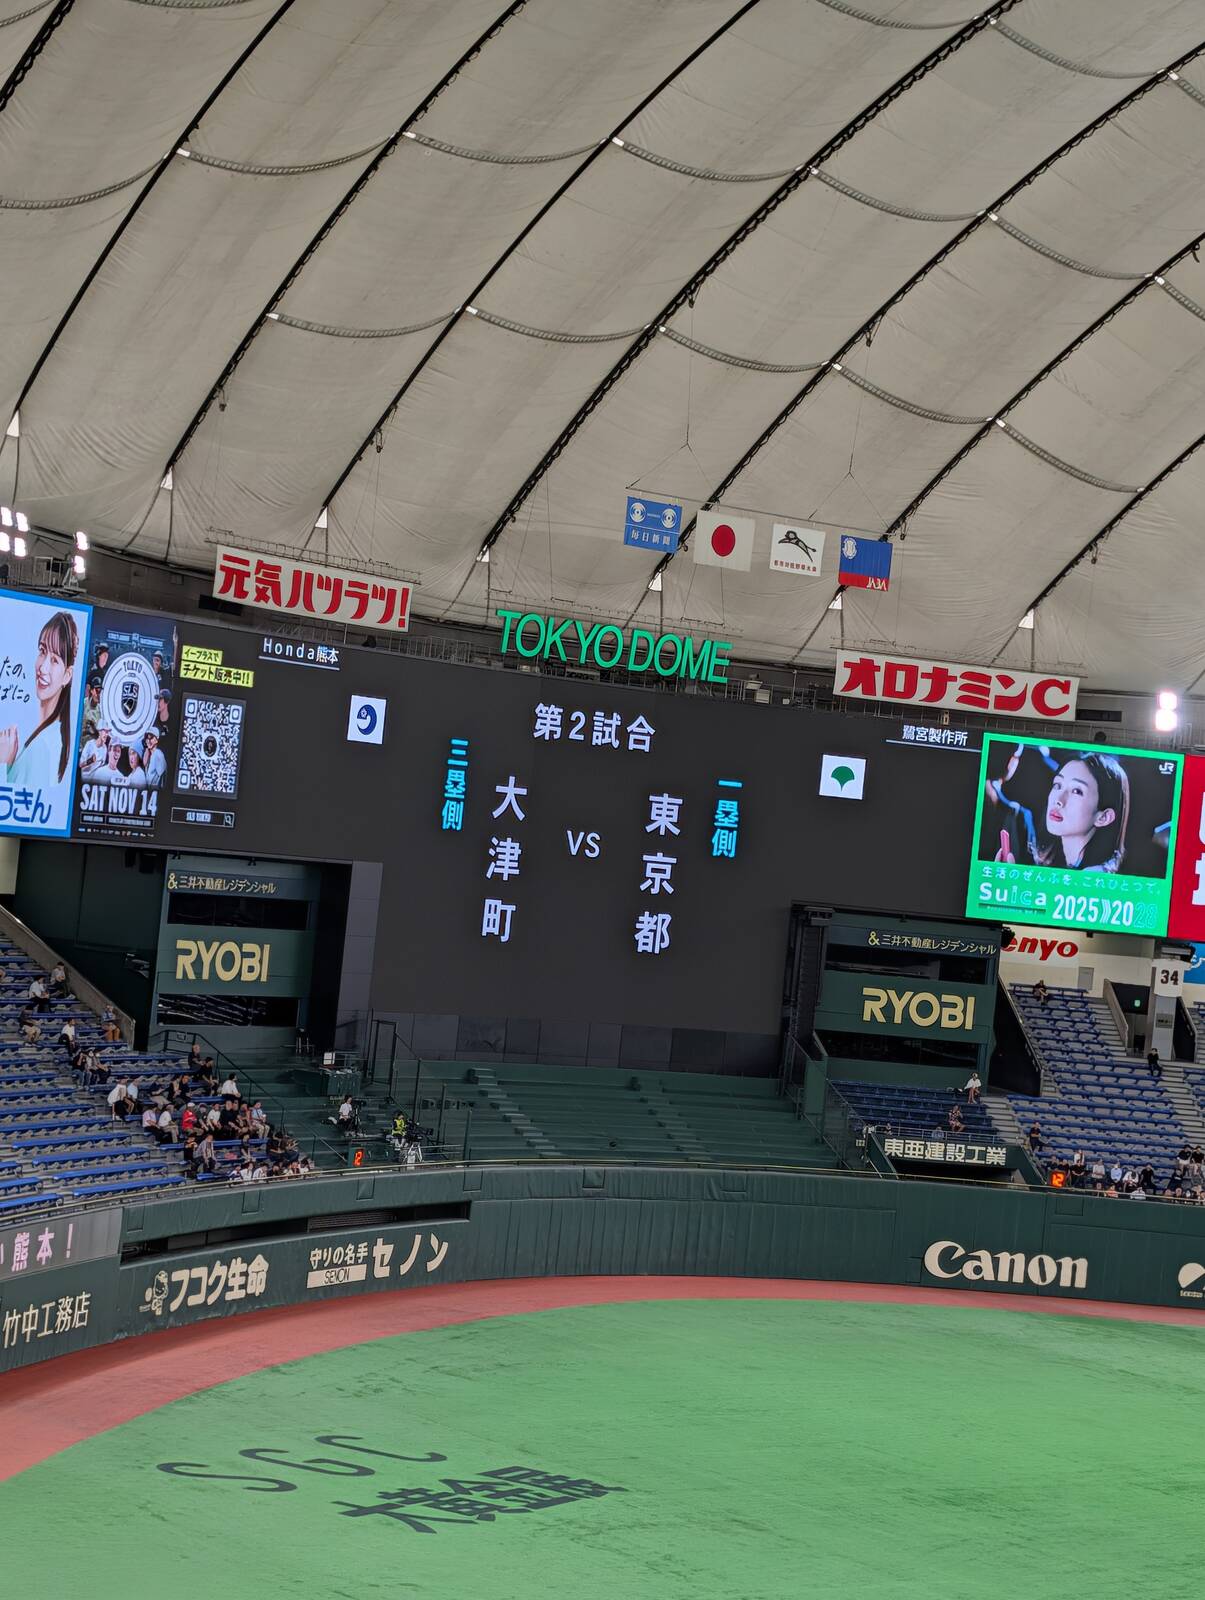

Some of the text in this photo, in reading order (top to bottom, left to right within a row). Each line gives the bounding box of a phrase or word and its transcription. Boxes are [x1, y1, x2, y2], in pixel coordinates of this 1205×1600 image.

[631, 529, 671, 545] 毎日新聞
[217, 554, 410, 628] 元気ハツラツ!
[263, 637, 339, 664] Honda熊本
[496, 609, 733, 684] TOKYO DOME
[840, 658, 1072, 717] オロナミンC
[533, 703, 656, 752] 第2試合
[902, 725, 968, 746] 鷺宮製作所
[80, 783, 107, 812] SAT
[108, 786, 137, 815] NOV
[139, 790, 158, 817] 14
[442, 739, 469, 831] 三塁側
[711, 779, 743, 858] 一塁側
[481, 776, 528, 943] 大津町
[566, 830, 601, 858] VS
[634, 793, 684, 954] 東京都
[979, 882, 1047, 906] Suica
[175, 939, 271, 983] RYOBI
[1160, 969, 1179, 985] 34
[862, 987, 976, 1030] RYOBI
[884, 1138, 1007, 1166] 東亜建設工業
[310, 1241, 369, 1269] 守りの名手
[372, 1233, 449, 1279] セノン
[924, 1240, 1088, 1289] Canon
[170, 1254, 269, 1312] フコク生命
[3, 1291, 91, 1349] 竹中工務店
